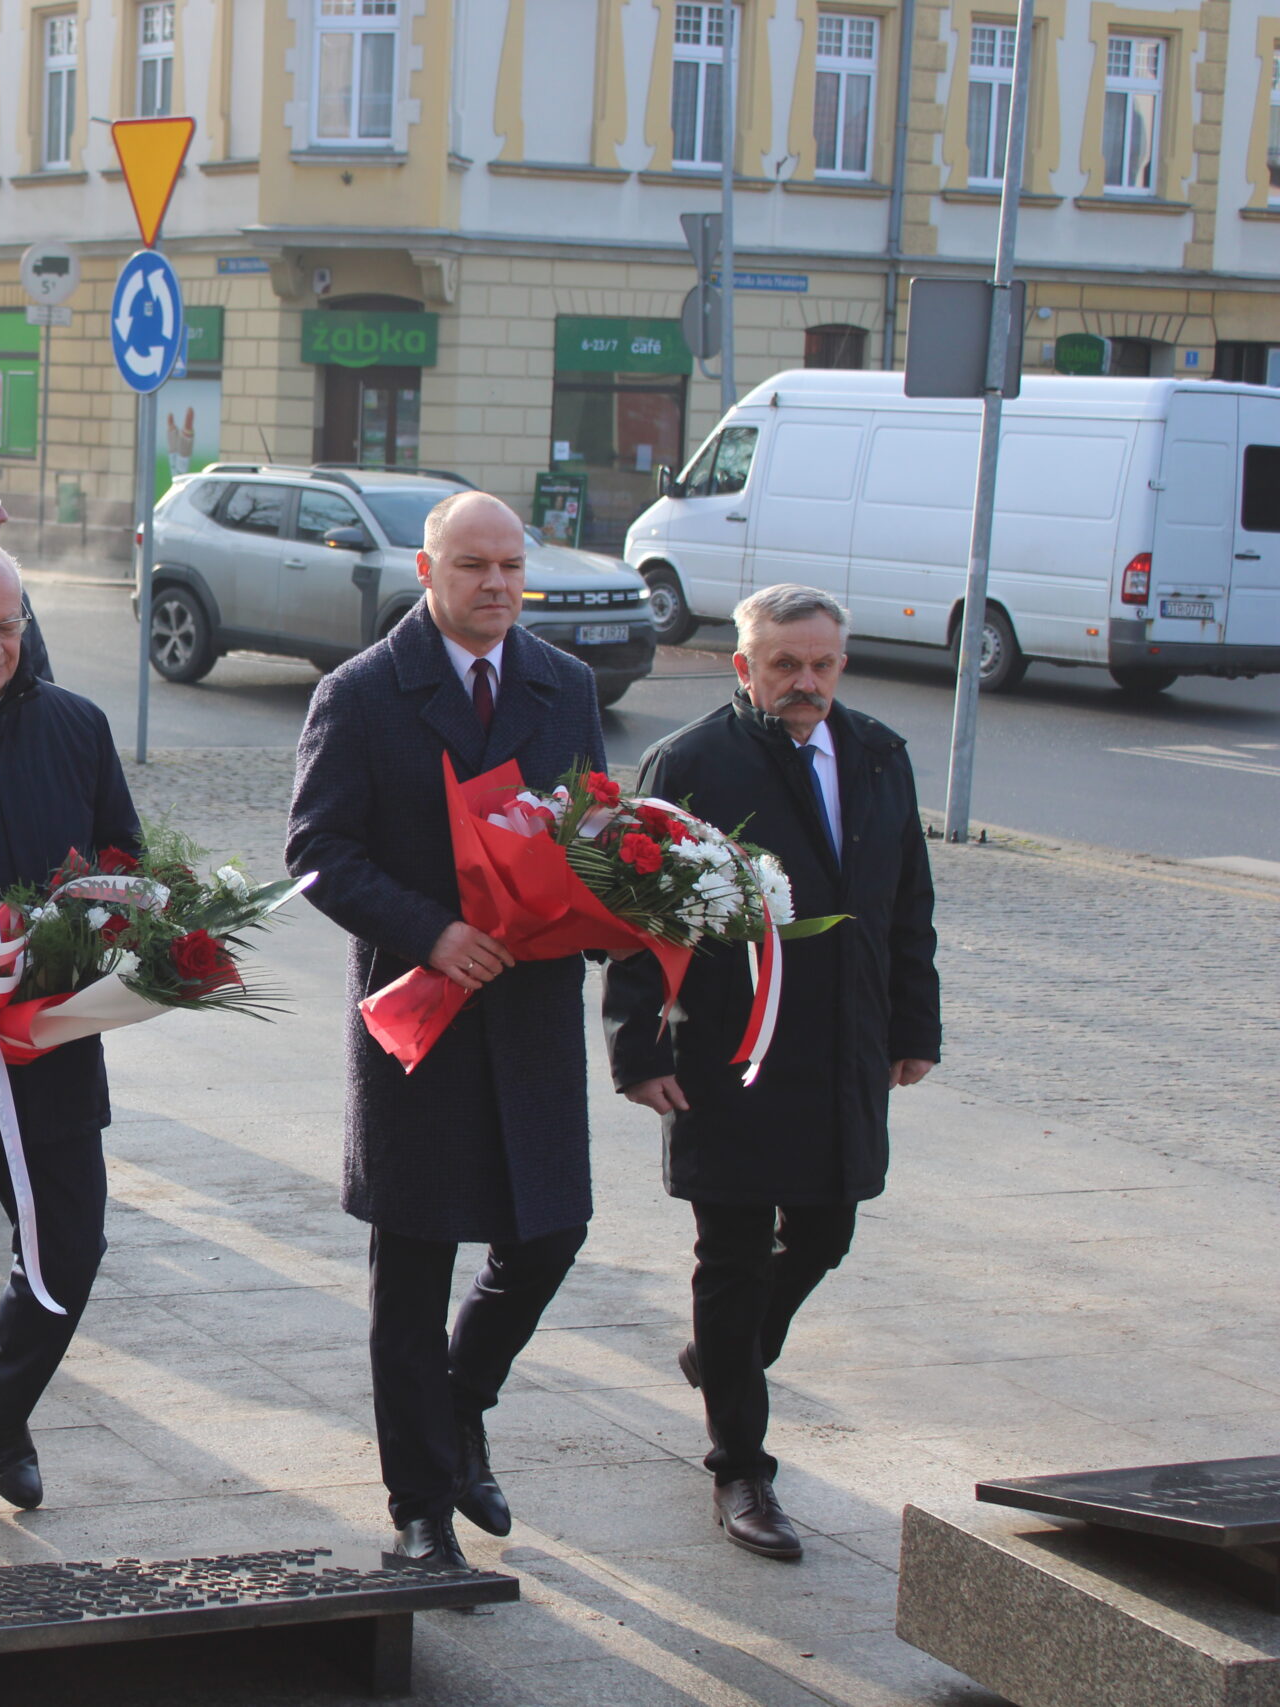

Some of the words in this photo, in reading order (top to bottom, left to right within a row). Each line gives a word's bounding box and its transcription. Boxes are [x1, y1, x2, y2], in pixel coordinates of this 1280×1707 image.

[312, 321, 426, 354] żabka
[580, 338, 618, 352] 6-23/7
[631, 337, 662, 355] café
